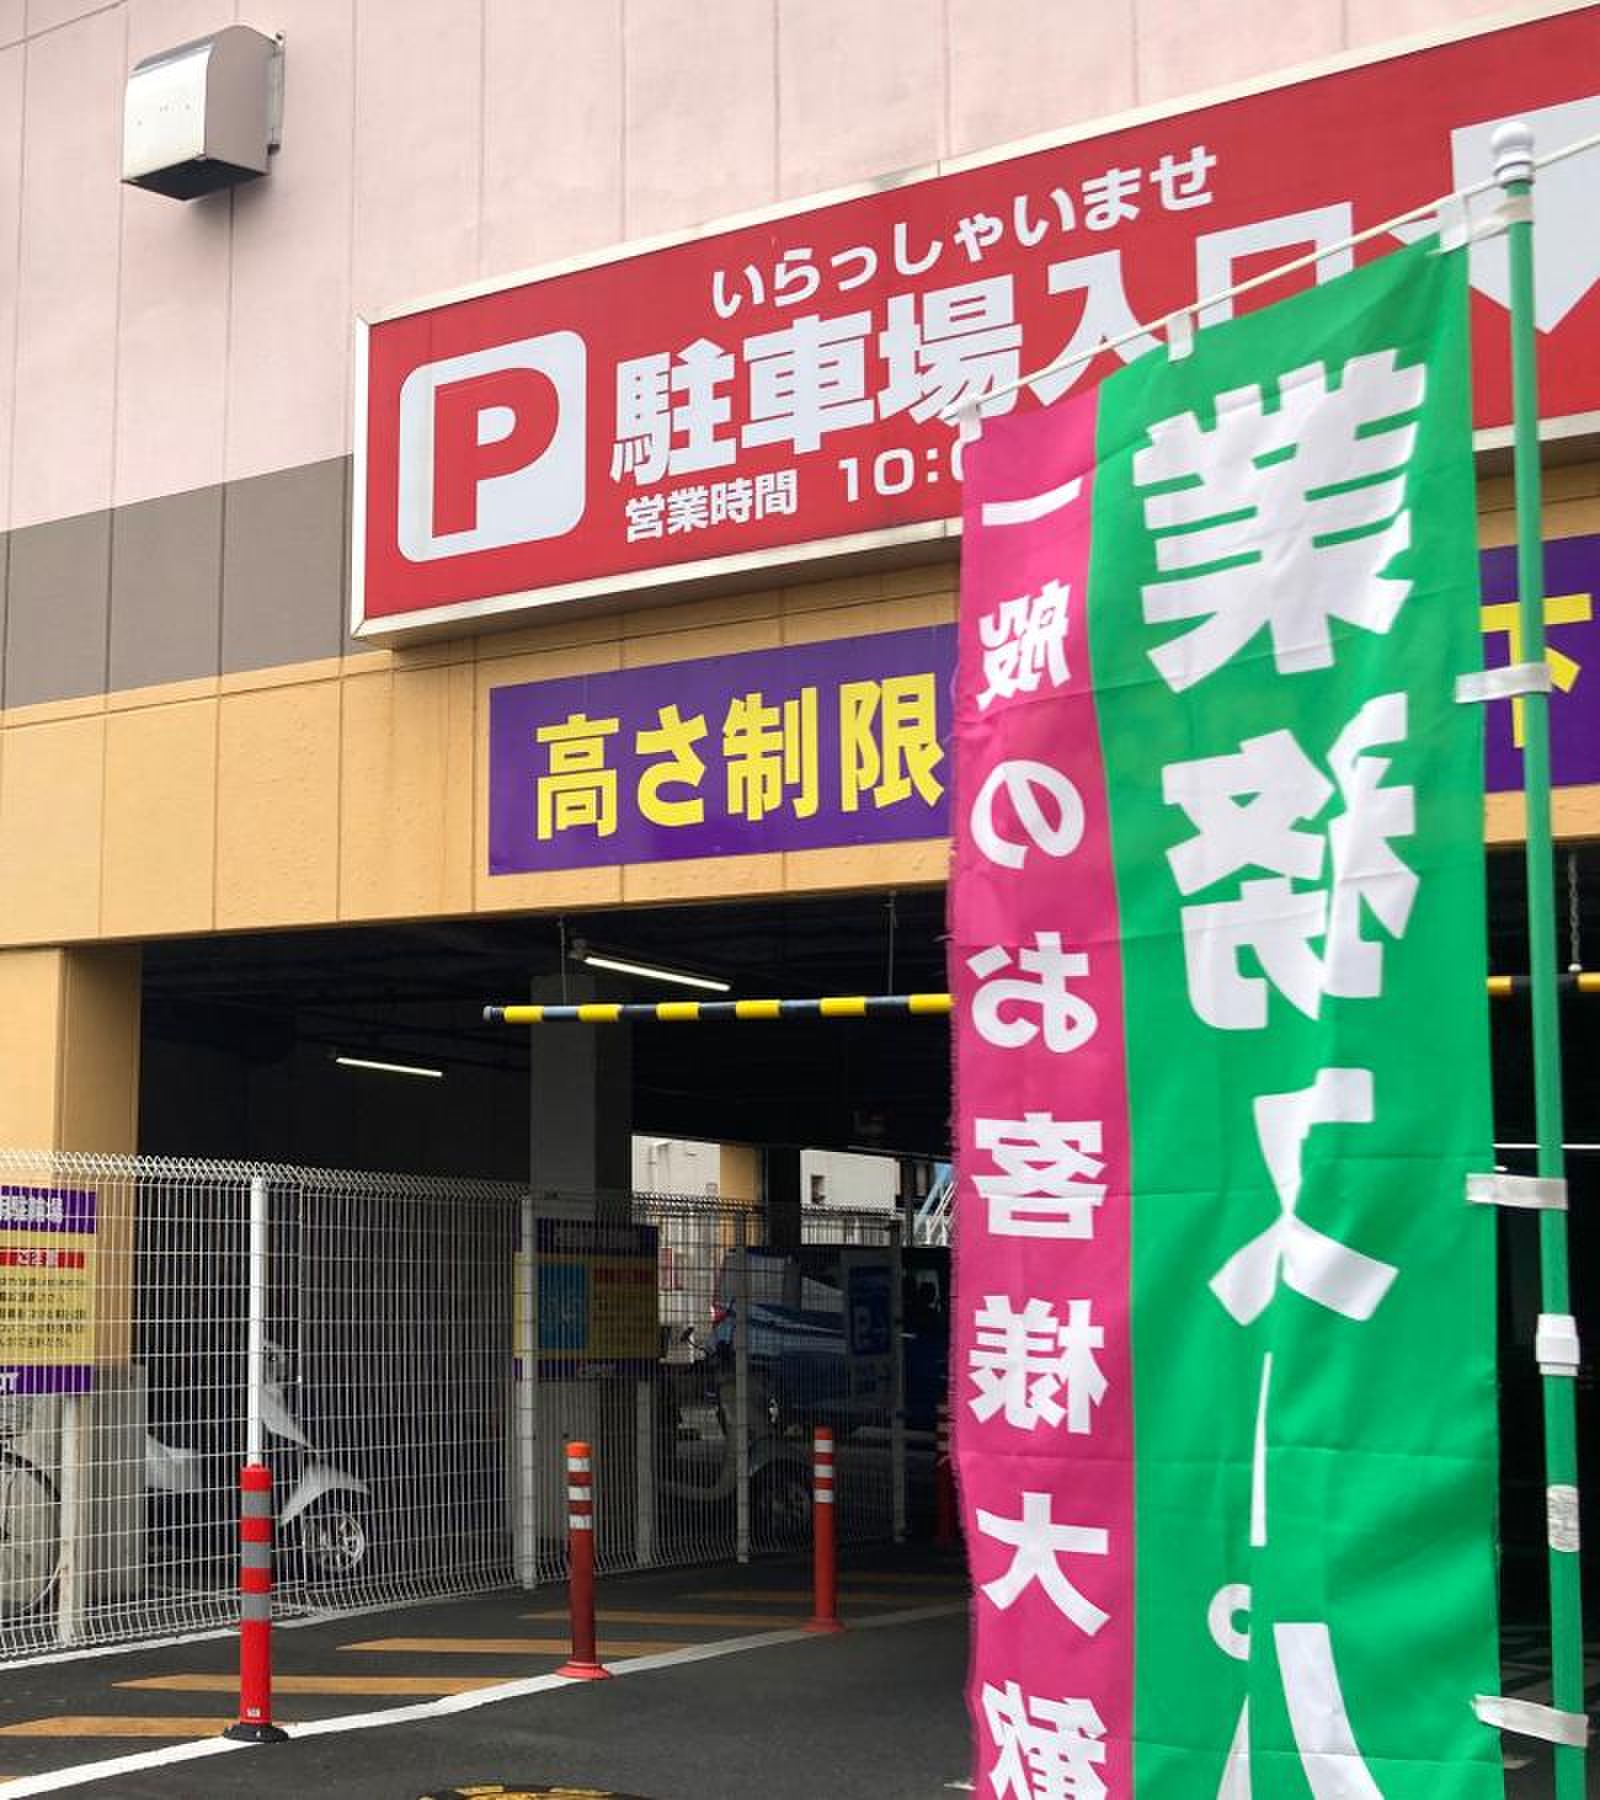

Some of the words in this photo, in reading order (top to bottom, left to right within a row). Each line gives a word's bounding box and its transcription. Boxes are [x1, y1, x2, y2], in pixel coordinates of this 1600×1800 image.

[713, 146, 1216, 317] いらっしゃいませ
[611, 201, 1354, 484] 駐車場入口
[432, 367, 561, 538] P
[625, 470, 797, 542] 営業時間
[535, 673, 944, 841] 高さ制限
